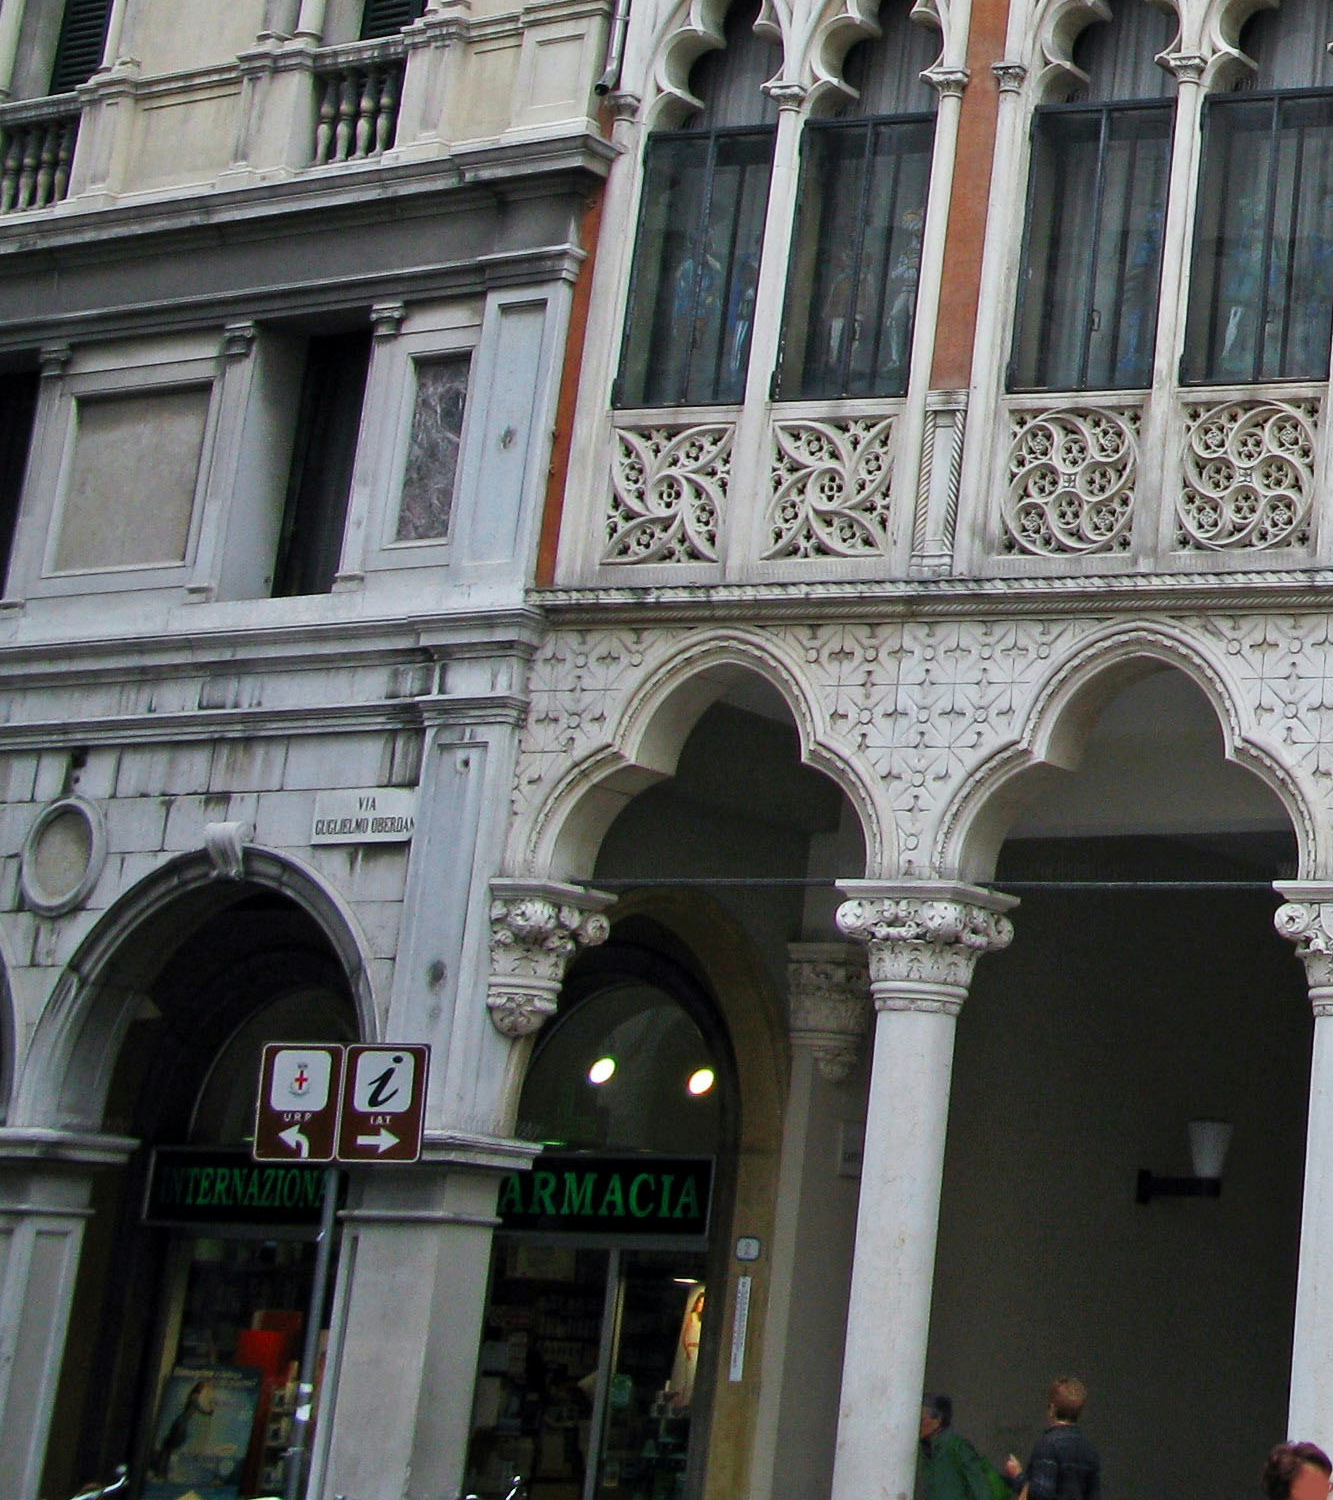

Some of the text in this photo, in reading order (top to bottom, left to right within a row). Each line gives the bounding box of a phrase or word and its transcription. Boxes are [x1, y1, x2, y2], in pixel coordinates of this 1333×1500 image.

[359, 796, 377, 811] VIA
[315, 817, 369, 835] GUGLIELMO
[499, 1171, 700, 1218] ARMACIA
